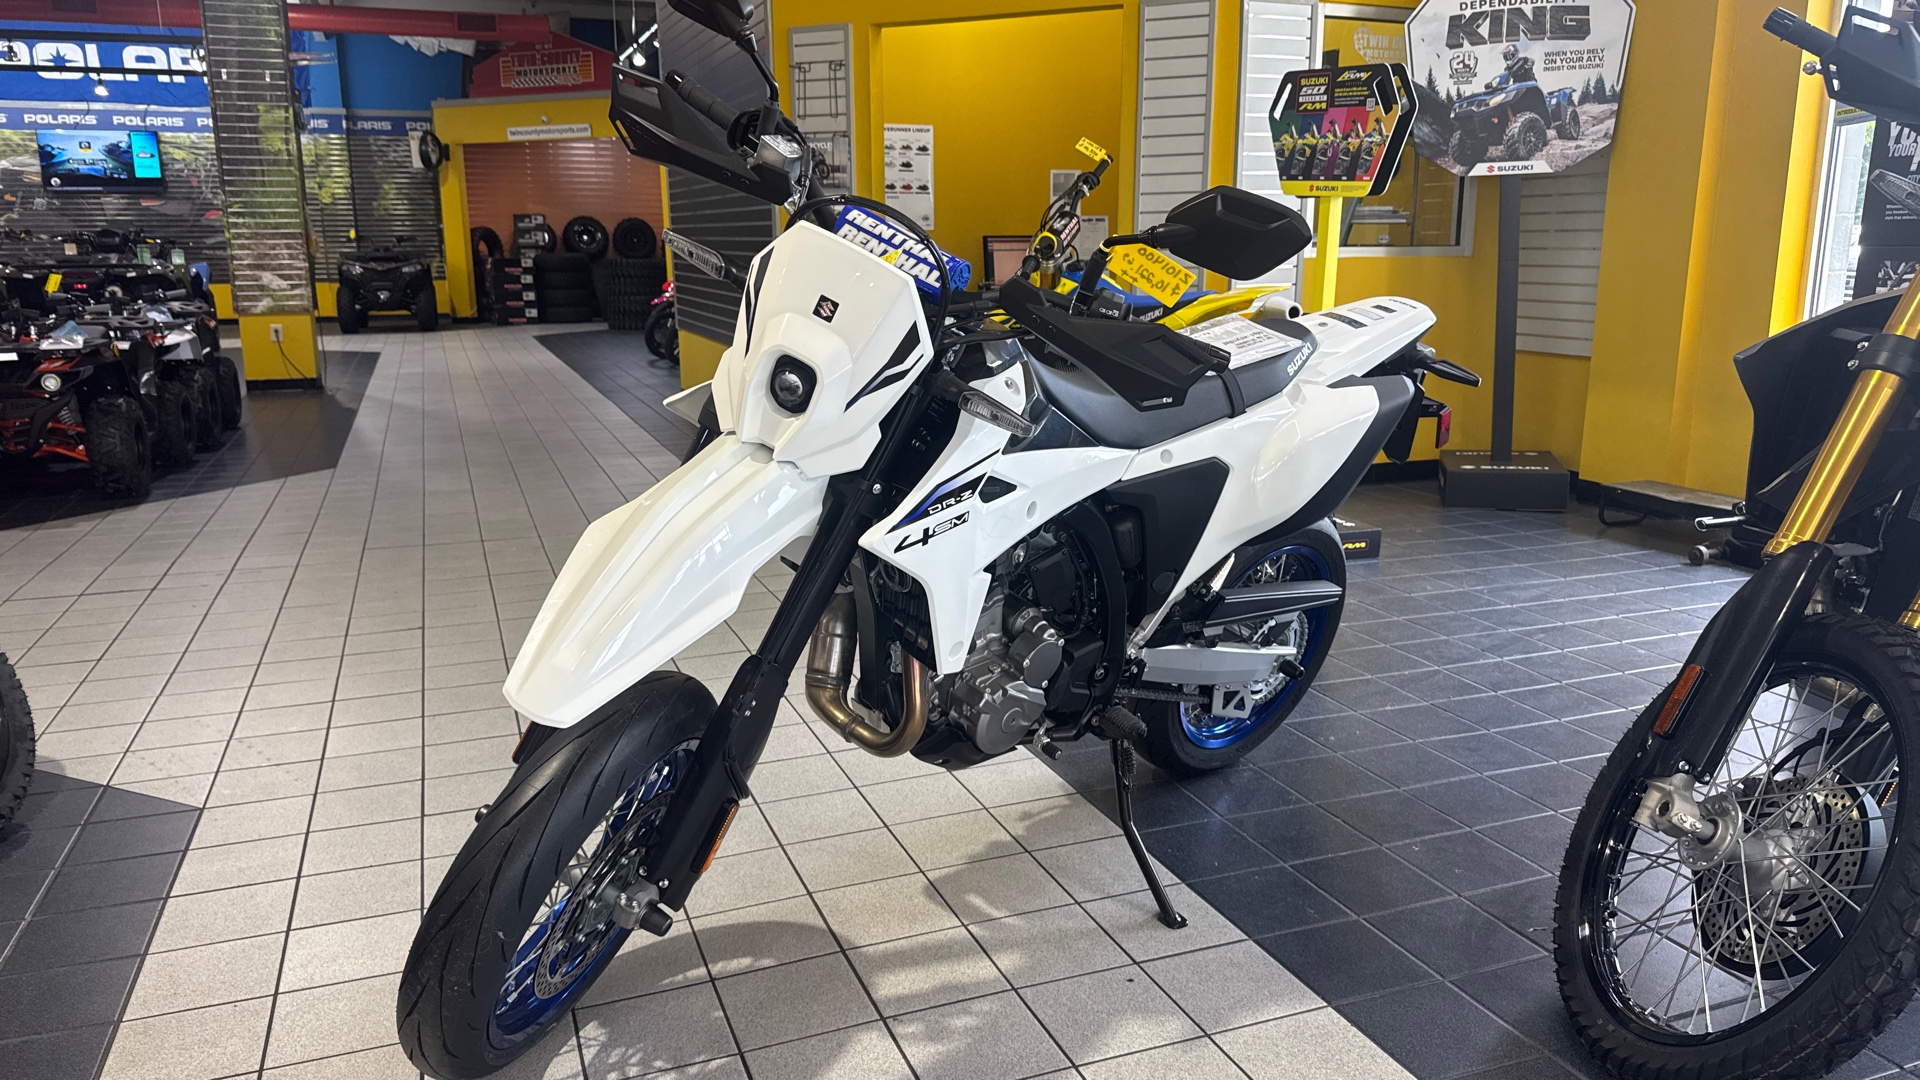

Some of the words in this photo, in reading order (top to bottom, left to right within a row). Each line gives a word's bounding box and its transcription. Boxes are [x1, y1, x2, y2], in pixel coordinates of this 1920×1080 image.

[1460, 0, 1578, 11] DEPENDA
[1445, 5, 1591, 50] KING
[1363, 34, 1389, 47] TWIN
[1453, 51, 1475, 68] 24
[1544, 50, 1567, 58] WHEN
[1559, 56, 1584, 64] YOUR
[515, 66, 578, 77] MOTORSPORTS
[1301, 77, 1328, 86] SUZUKI
[1300, 85, 1328, 95] 50
[24, 114, 97, 125] POLARIS
[113, 115, 184, 127] POLARIS
[1286, 341, 1313, 376] SUZUKI
[927, 489, 973, 515] DR-Z
